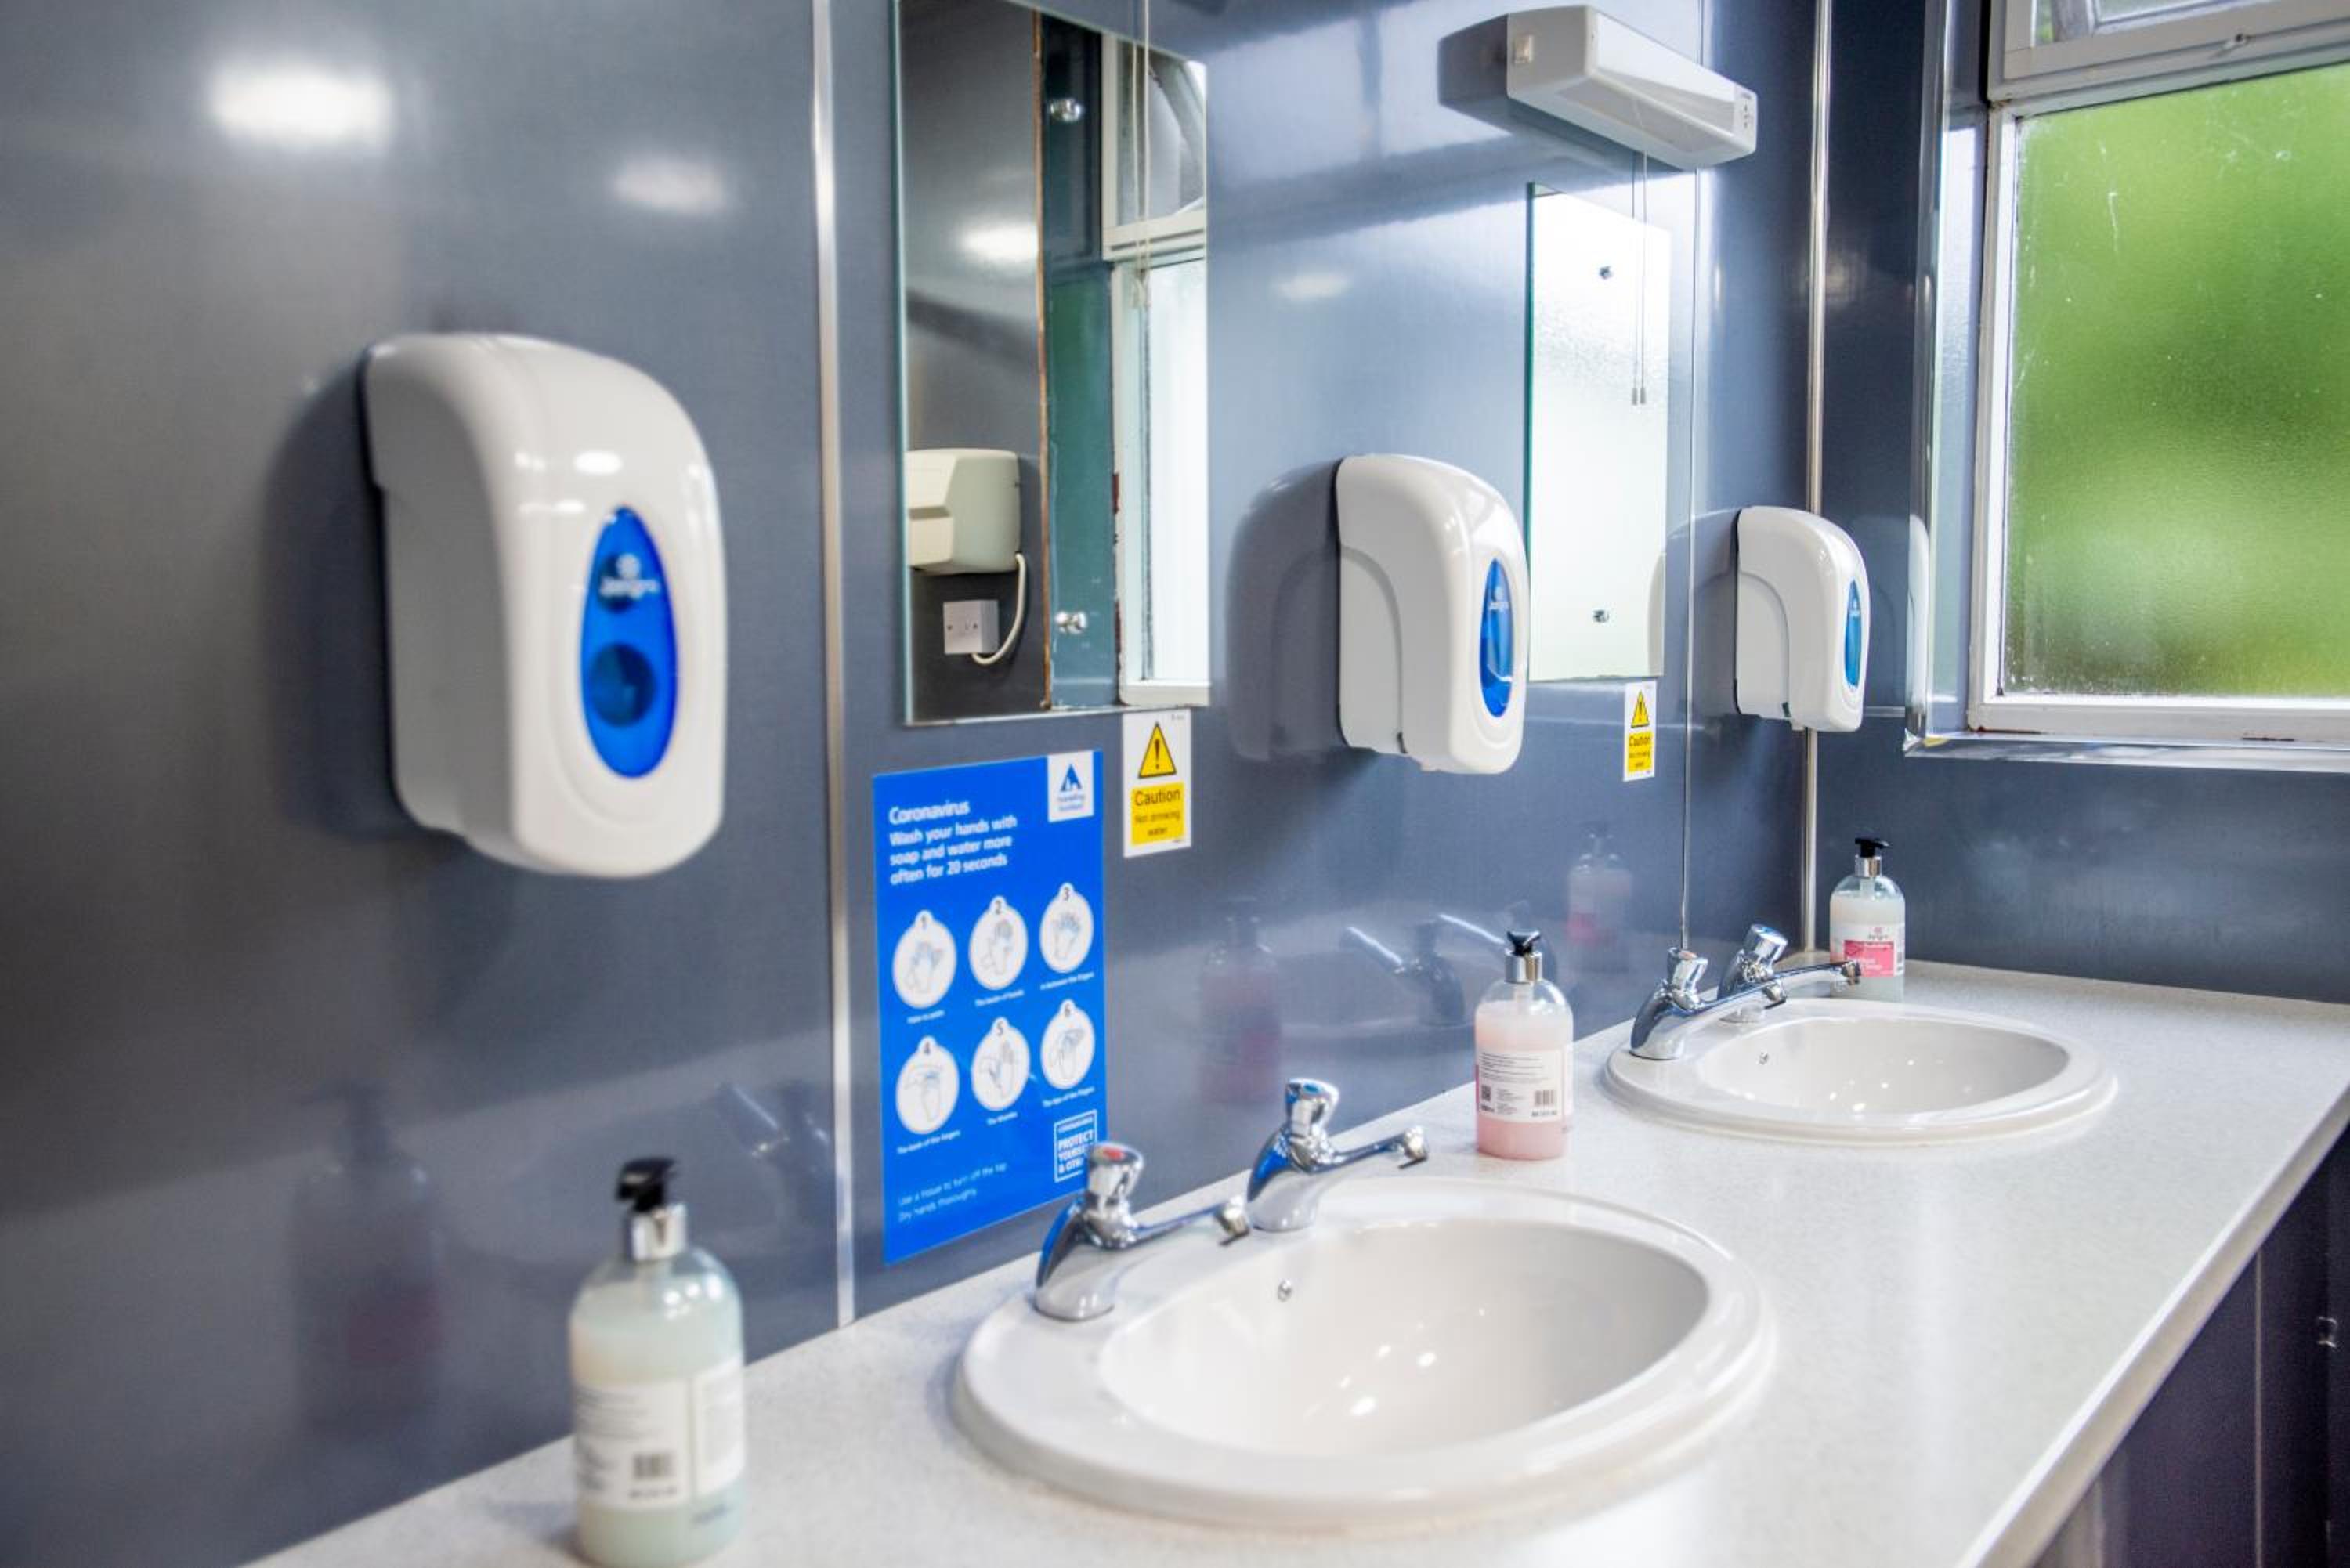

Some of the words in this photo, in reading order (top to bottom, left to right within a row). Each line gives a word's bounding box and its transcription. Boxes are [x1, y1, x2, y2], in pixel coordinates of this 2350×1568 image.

[1135, 788, 1181, 807] Caution
[889, 800, 971, 825] Coronavirus
[890, 829, 923, 846] Wash
[925, 827, 952, 844] your
[956, 819, 989, 836] hands
[991, 815, 1018, 830] with
[890, 851, 920, 866] soap
[922, 844, 945, 861] and
[948, 840, 982, 855] water
[984, 836, 1012, 850] more
[890, 869, 924, 885] often
[927, 864, 943, 878] for
[947, 860, 961, 875] 20
[964, 852, 1007, 873] seconds
[1063, 887, 1070, 901] 3
[994, 900, 1003, 915] 2
[920, 916, 928, 930] 1
[1064, 1002, 1072, 1017] 6
[996, 1021, 1004, 1036] 5
[923, 1041, 931, 1055] 4
[1058, 1129, 1094, 1151] PROTECT
